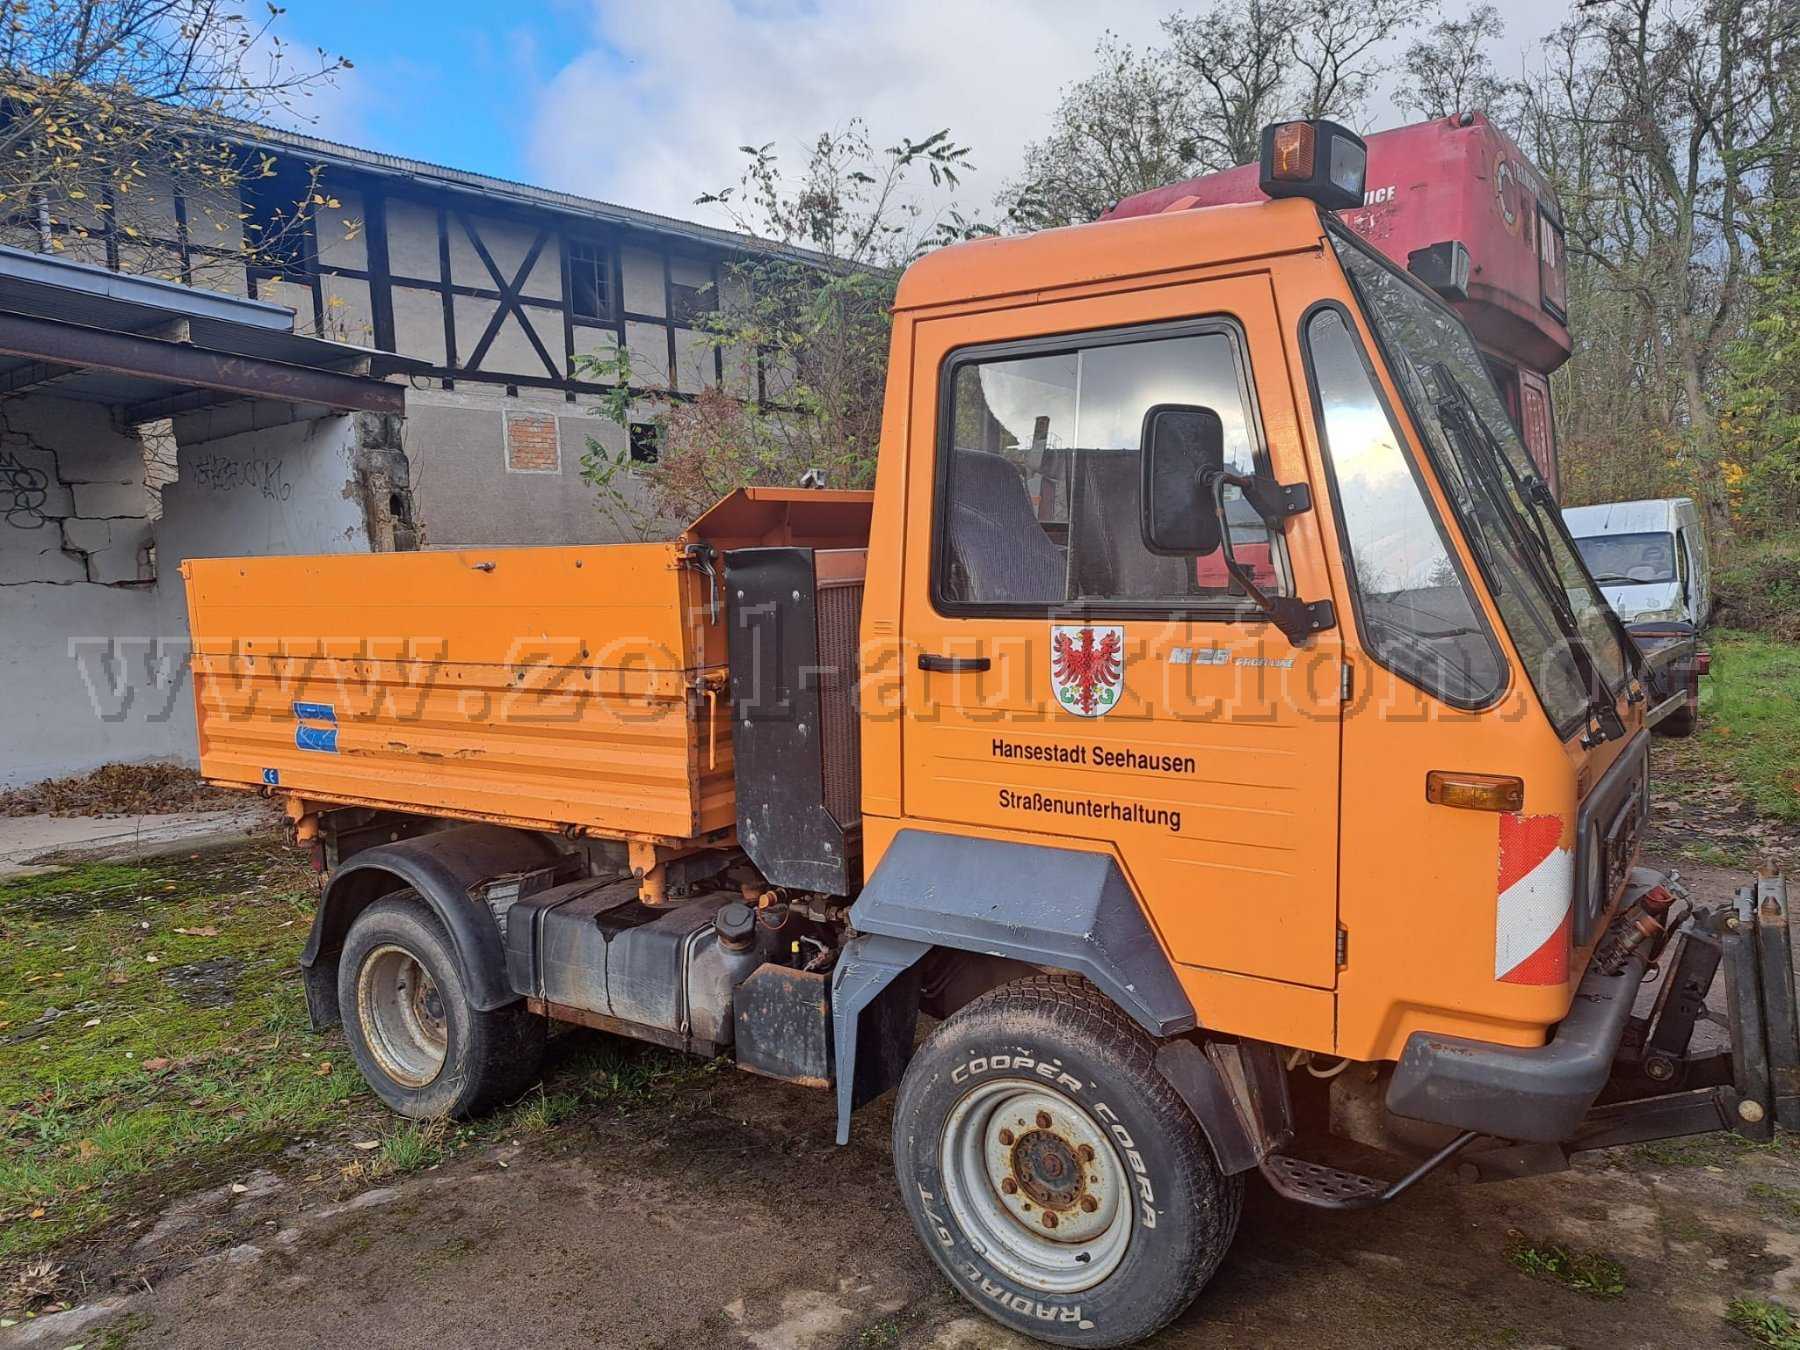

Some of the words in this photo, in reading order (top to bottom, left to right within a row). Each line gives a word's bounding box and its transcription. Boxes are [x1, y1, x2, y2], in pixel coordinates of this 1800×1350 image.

[992, 739, 1086, 764] Hansestadt
[1092, 746, 1195, 773] Seehausen
[999, 789, 1181, 831] Straßenunterhaltung
[951, 1055, 1082, 1093] COOPER
[1095, 1102, 1157, 1229] COBRA
[966, 1262, 1082, 1322] RADIAL
